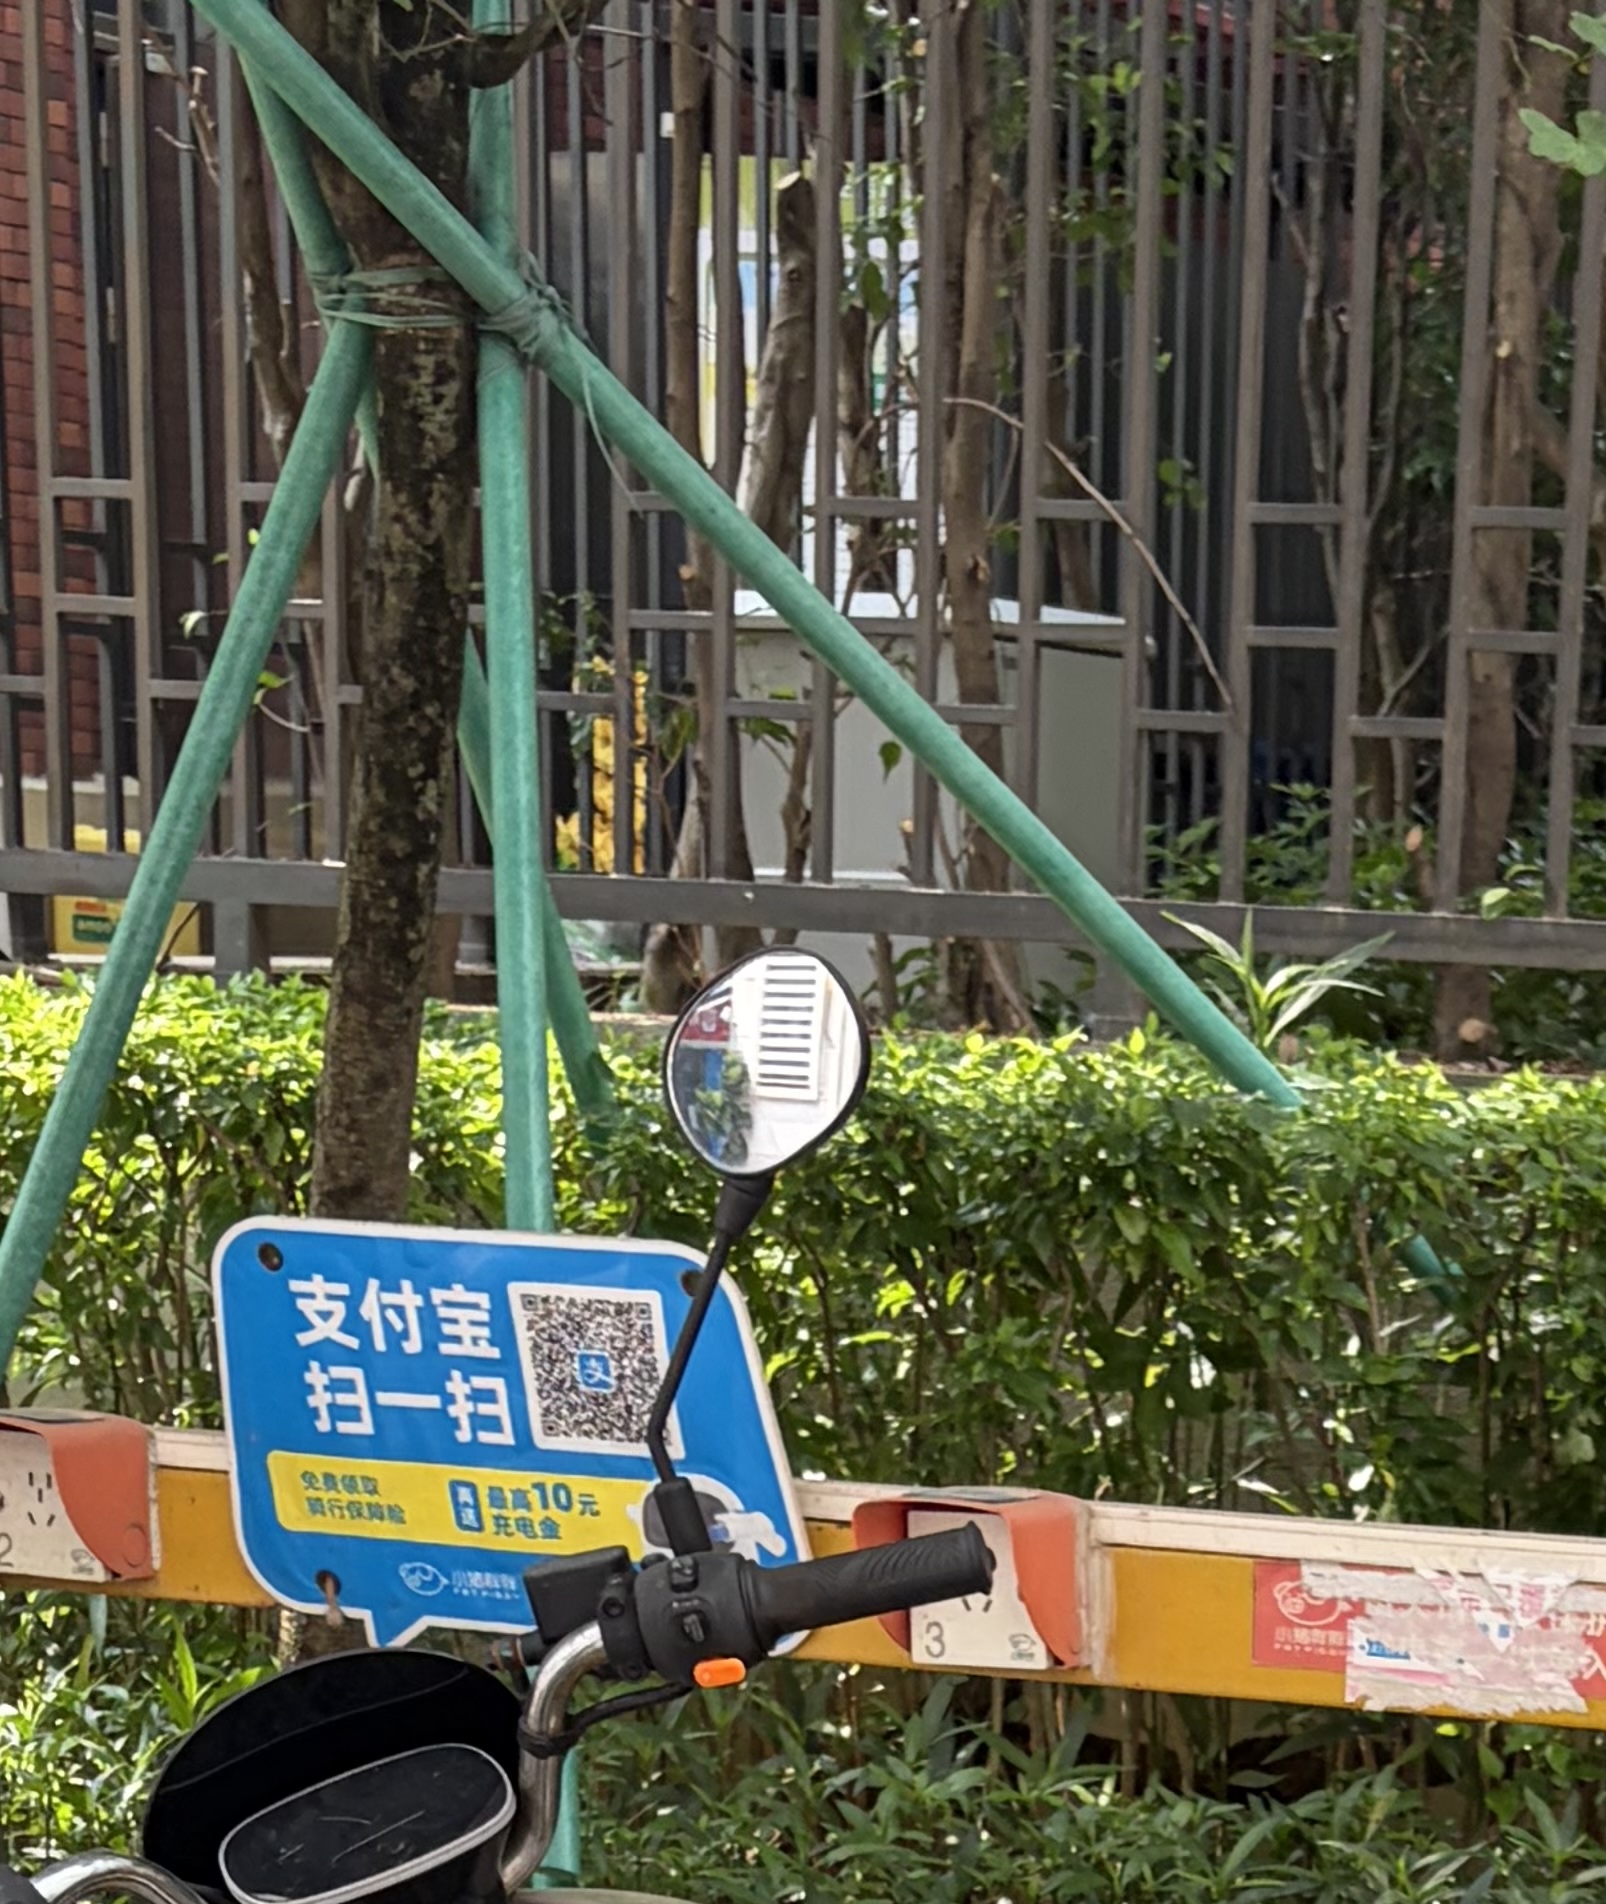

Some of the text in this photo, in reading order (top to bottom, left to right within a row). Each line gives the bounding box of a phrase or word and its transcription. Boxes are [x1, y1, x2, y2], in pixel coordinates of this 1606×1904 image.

[287, 1273, 501, 1360] 支付宝
[303, 1360, 516, 1446] 扫一扫
[300, 1469, 382, 1498] 免费领取
[487, 1482, 601, 1517] 最高10元
[305, 1496, 407, 1526] 骑行保障险
[492, 1514, 563, 1541] 充电金
[925, 1620, 946, 1659] 3
